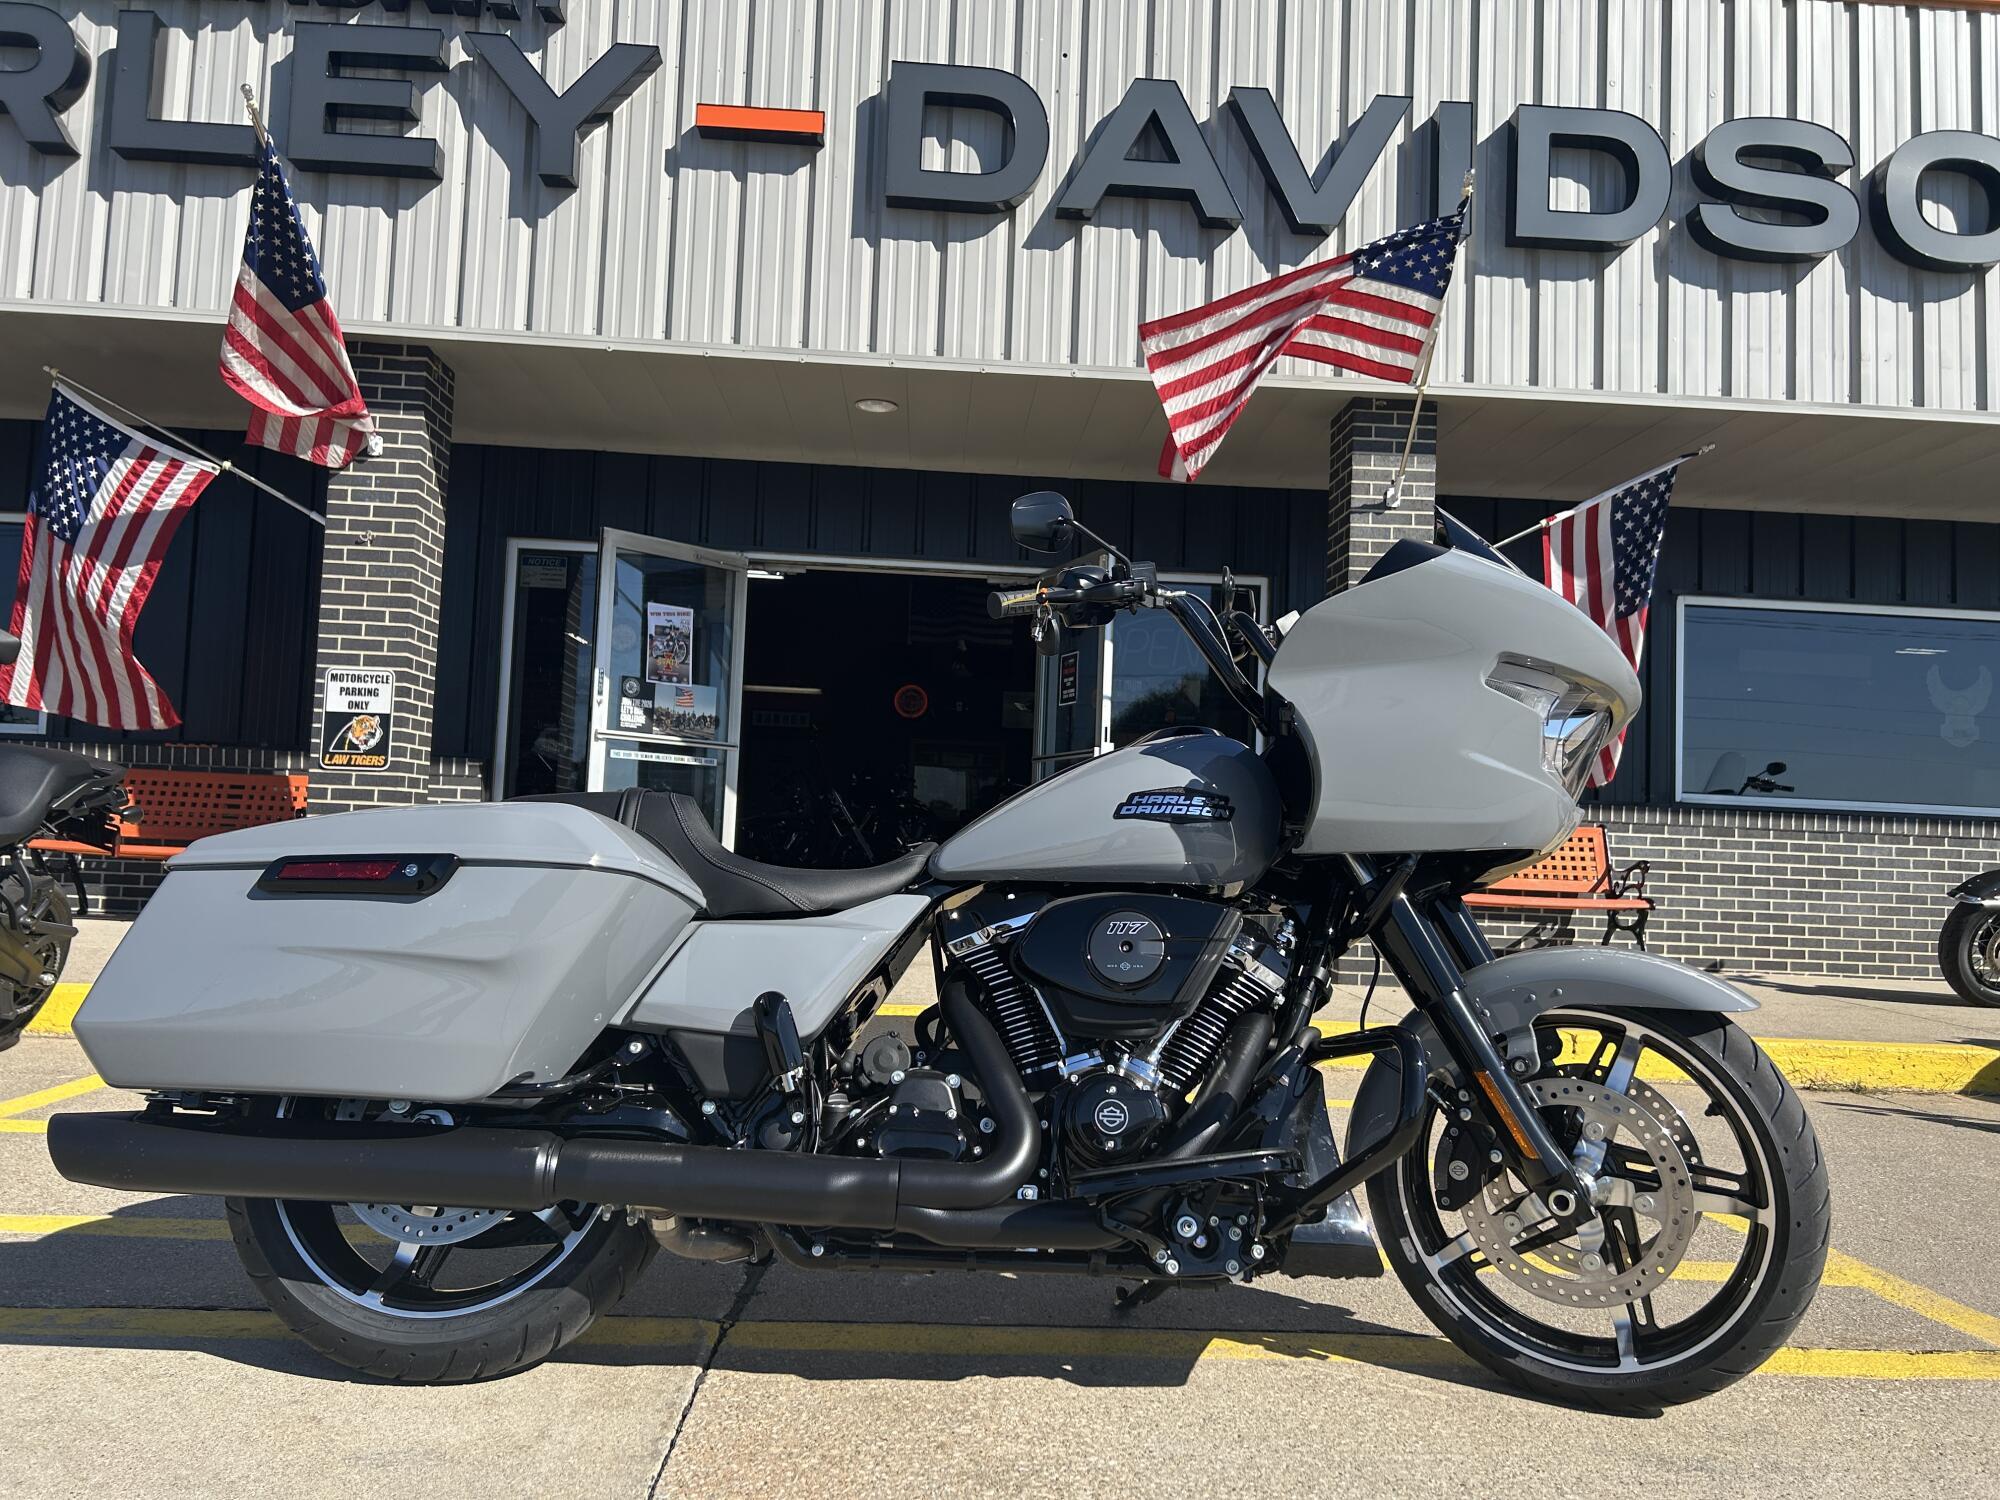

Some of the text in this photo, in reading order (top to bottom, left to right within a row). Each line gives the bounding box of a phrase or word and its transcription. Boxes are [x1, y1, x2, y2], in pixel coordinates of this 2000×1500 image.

[528, 558, 561, 567] NOTICE
[330, 673, 391, 684] MOTORCYCLE
[339, 687, 379, 697] PARKING
[347, 700, 370, 710] ONLY
[324, 754, 385, 766] LAW TIGERS
[1106, 921, 1149, 935] 117
